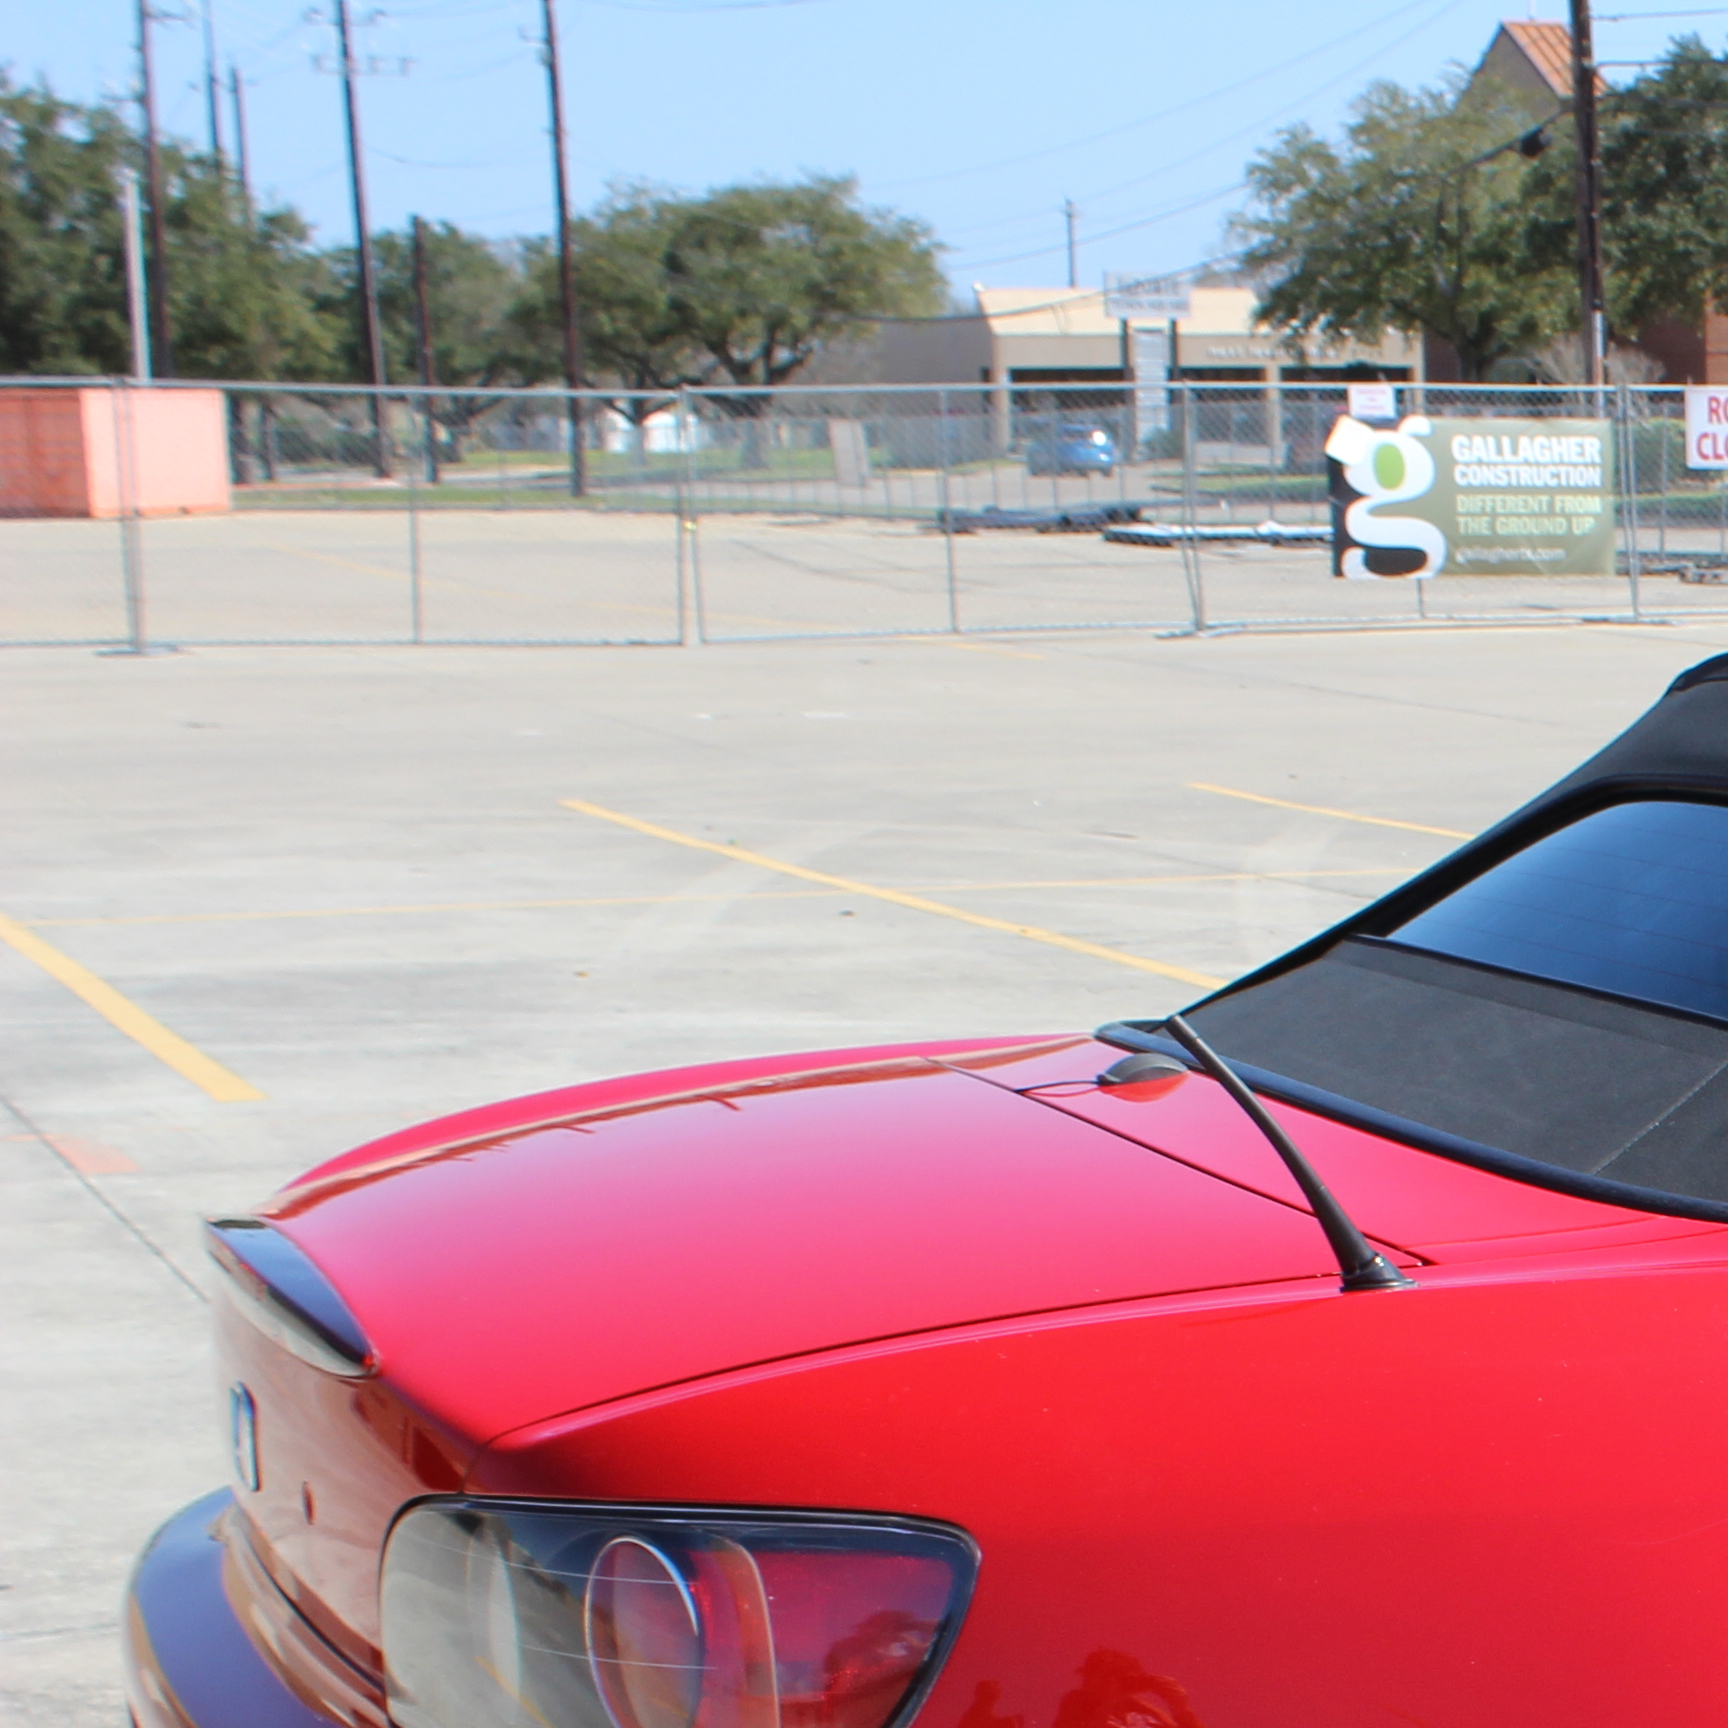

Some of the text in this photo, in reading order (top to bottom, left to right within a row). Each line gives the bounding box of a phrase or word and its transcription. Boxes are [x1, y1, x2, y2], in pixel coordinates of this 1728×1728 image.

[1451, 435, 1602, 464] GALLAGHER
[1454, 465, 1602, 487] CONSTRUCTION
[1456, 494, 1602, 515] DIFFERENT FROM
[1456, 516, 1597, 536] THE GROUND UP
